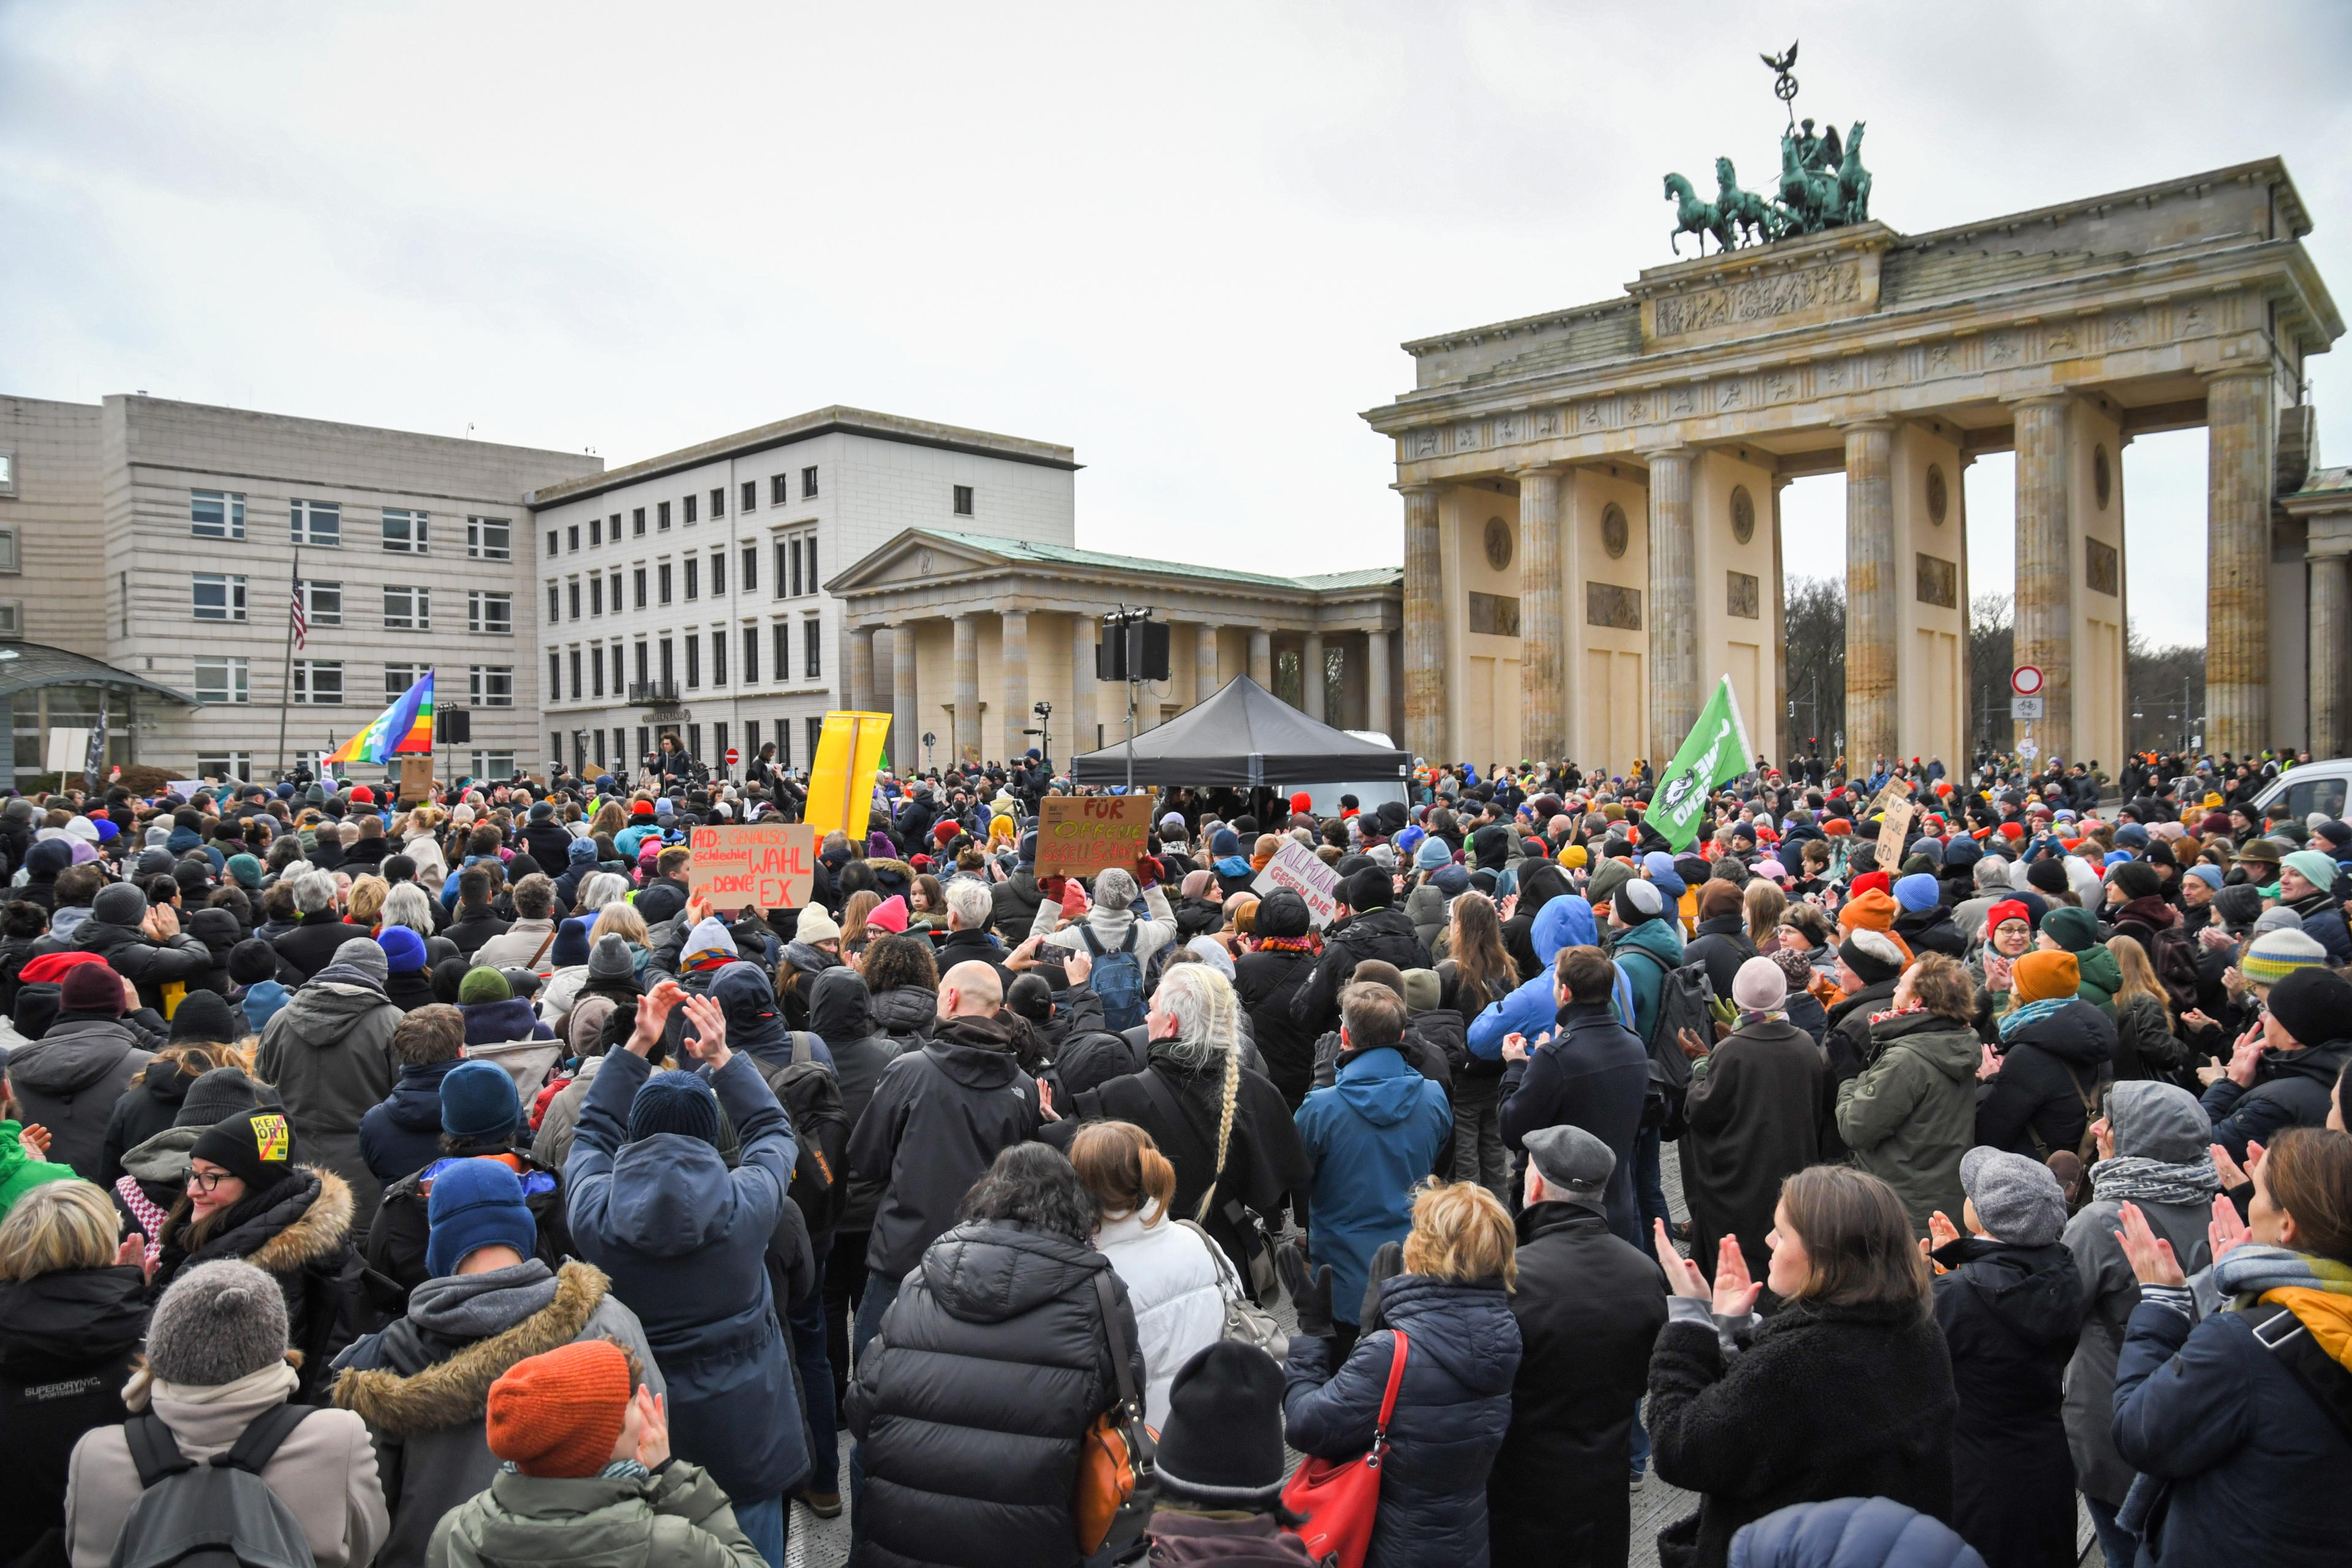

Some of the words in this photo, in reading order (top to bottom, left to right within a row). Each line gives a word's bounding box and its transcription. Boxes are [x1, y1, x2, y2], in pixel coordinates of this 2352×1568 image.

[1084, 799, 1125, 820] FÜR
[1890, 799, 1902, 813] NO
[1054, 821, 1142, 839] OFFENE
[1883, 815, 1904, 835] FUTURE
[692, 829, 722, 848] AfD:
[728, 829, 788, 845] GENAUSO
[1887, 832, 1893, 843] 4
[748, 847, 811, 874] WAHL
[760, 878, 794, 907] EX
[1270, 867, 1310, 897] GEGEN
[1308, 894, 1332, 916] DIE
[254, 1118, 284, 1128] KEIN
[258, 1127, 285, 1139] ORT
[39, 1387, 85, 1400] SPORTSWEAR
